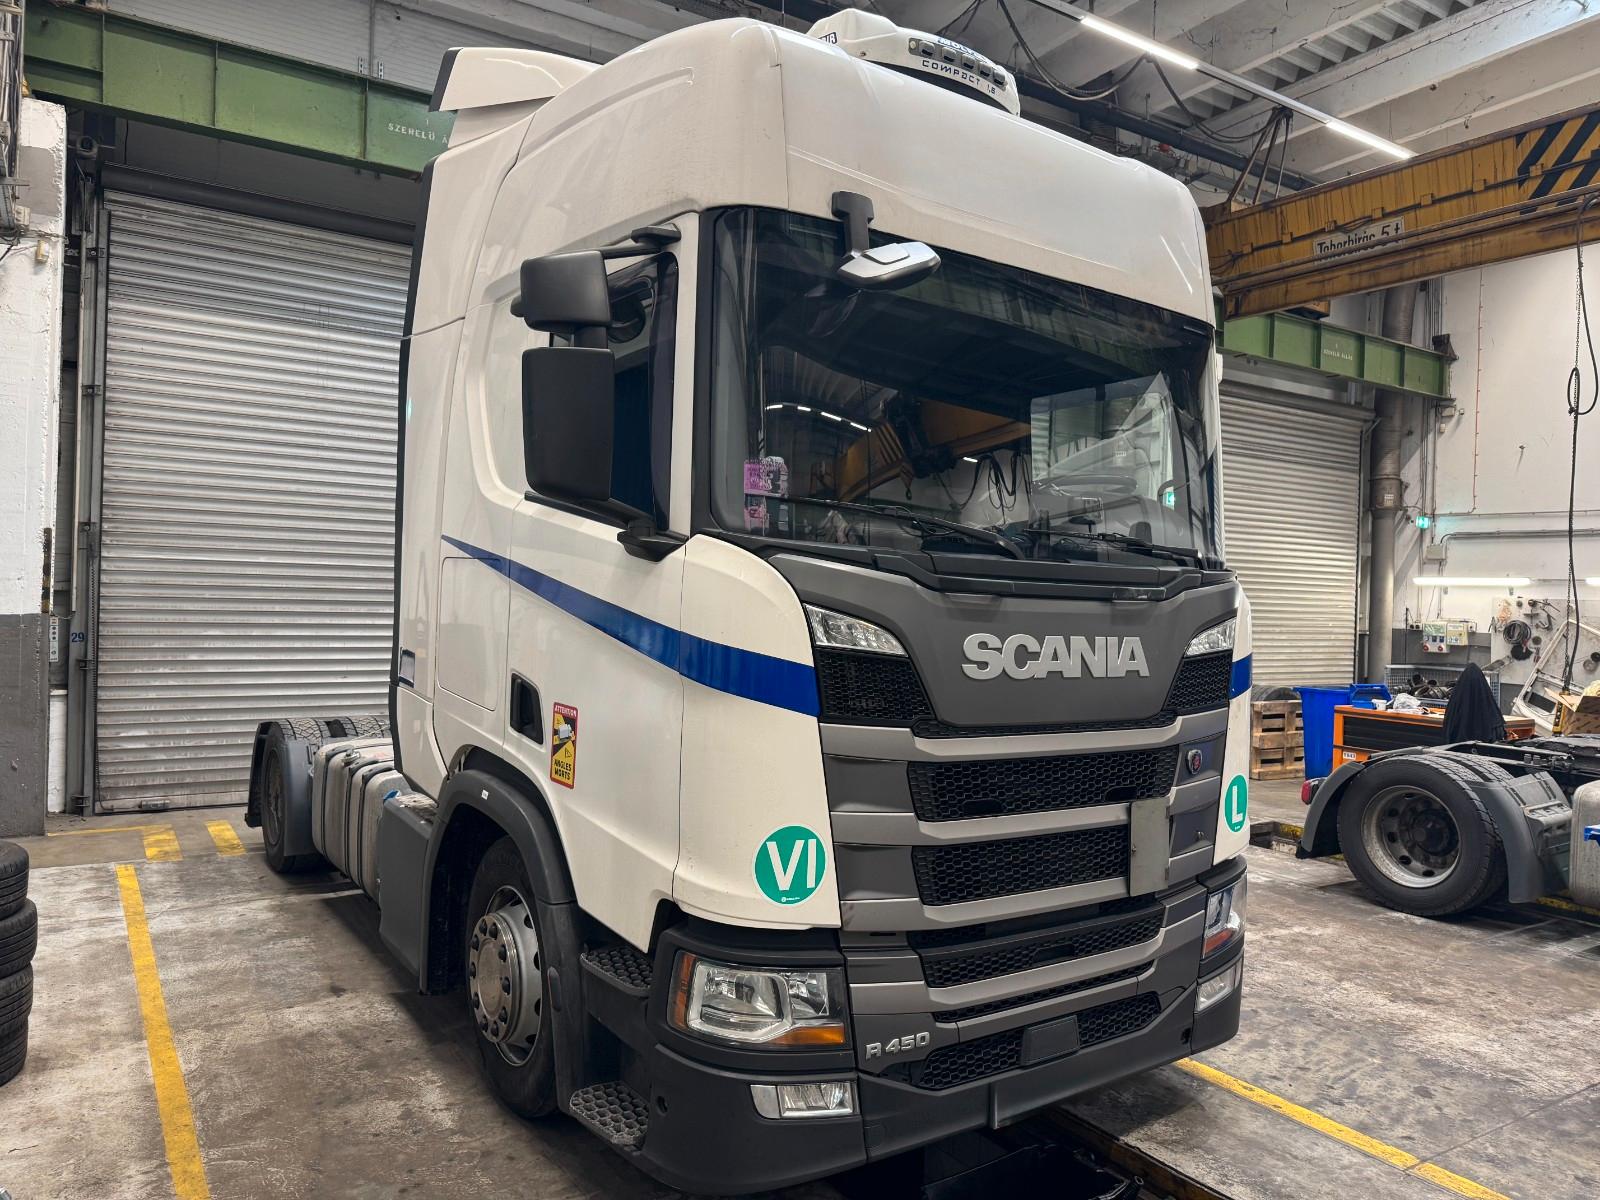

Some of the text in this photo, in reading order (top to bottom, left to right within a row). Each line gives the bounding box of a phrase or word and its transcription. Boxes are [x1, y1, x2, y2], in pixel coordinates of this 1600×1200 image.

[922, 60, 980, 85] COMPACT
[71, 632, 85, 643] 29
[962, 633, 1150, 680] SCANIA
[554, 759, 572, 772] ANGLES
[554, 768, 571, 780] MORTS
[1232, 785, 1243, 824] L
[766, 838, 817, 891] VI
[866, 1031, 930, 1061] R 450
